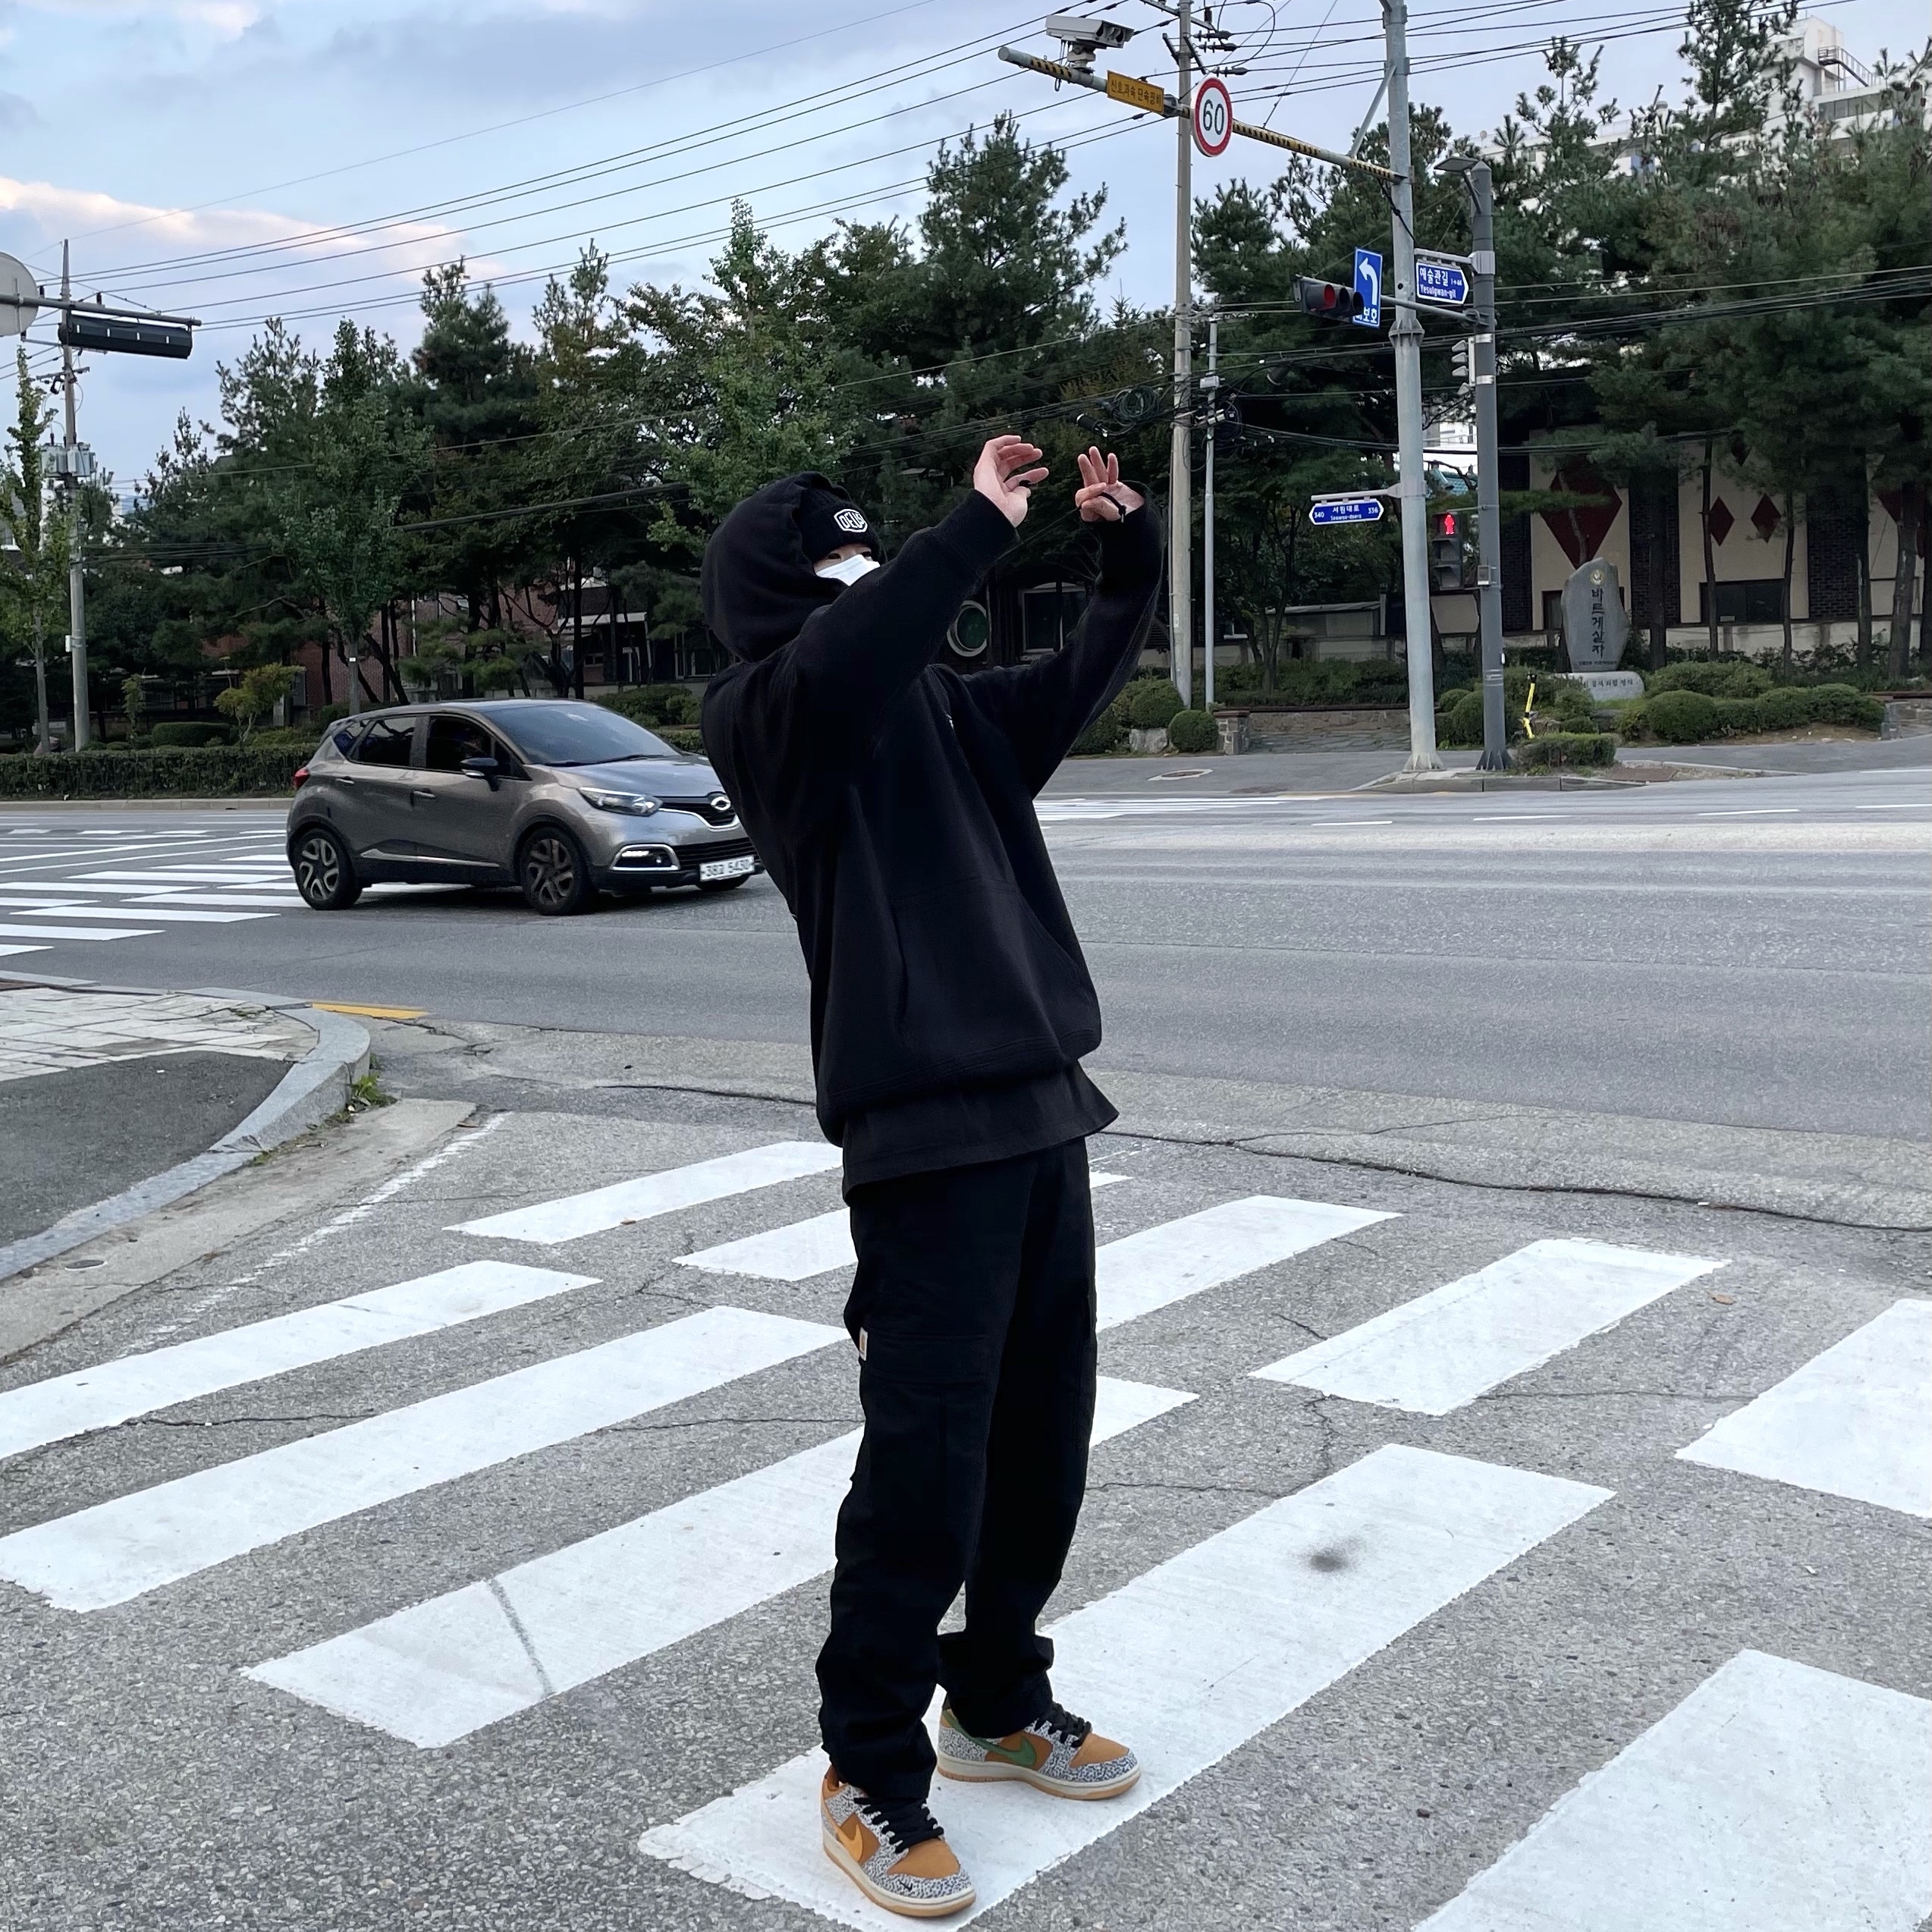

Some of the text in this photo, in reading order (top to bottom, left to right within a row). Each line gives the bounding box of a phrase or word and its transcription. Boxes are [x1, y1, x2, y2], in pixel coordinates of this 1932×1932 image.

[1138, 87, 1162, 108] 단속장비
[1203, 99, 1224, 135] 60
[1419, 268, 1448, 287] 예술관길
[1420, 284, 1456, 299] Yesulgwan-gil
[1332, 504, 1359, 514] 서원대로
[1591, 588, 1605, 658] 바르게살자
